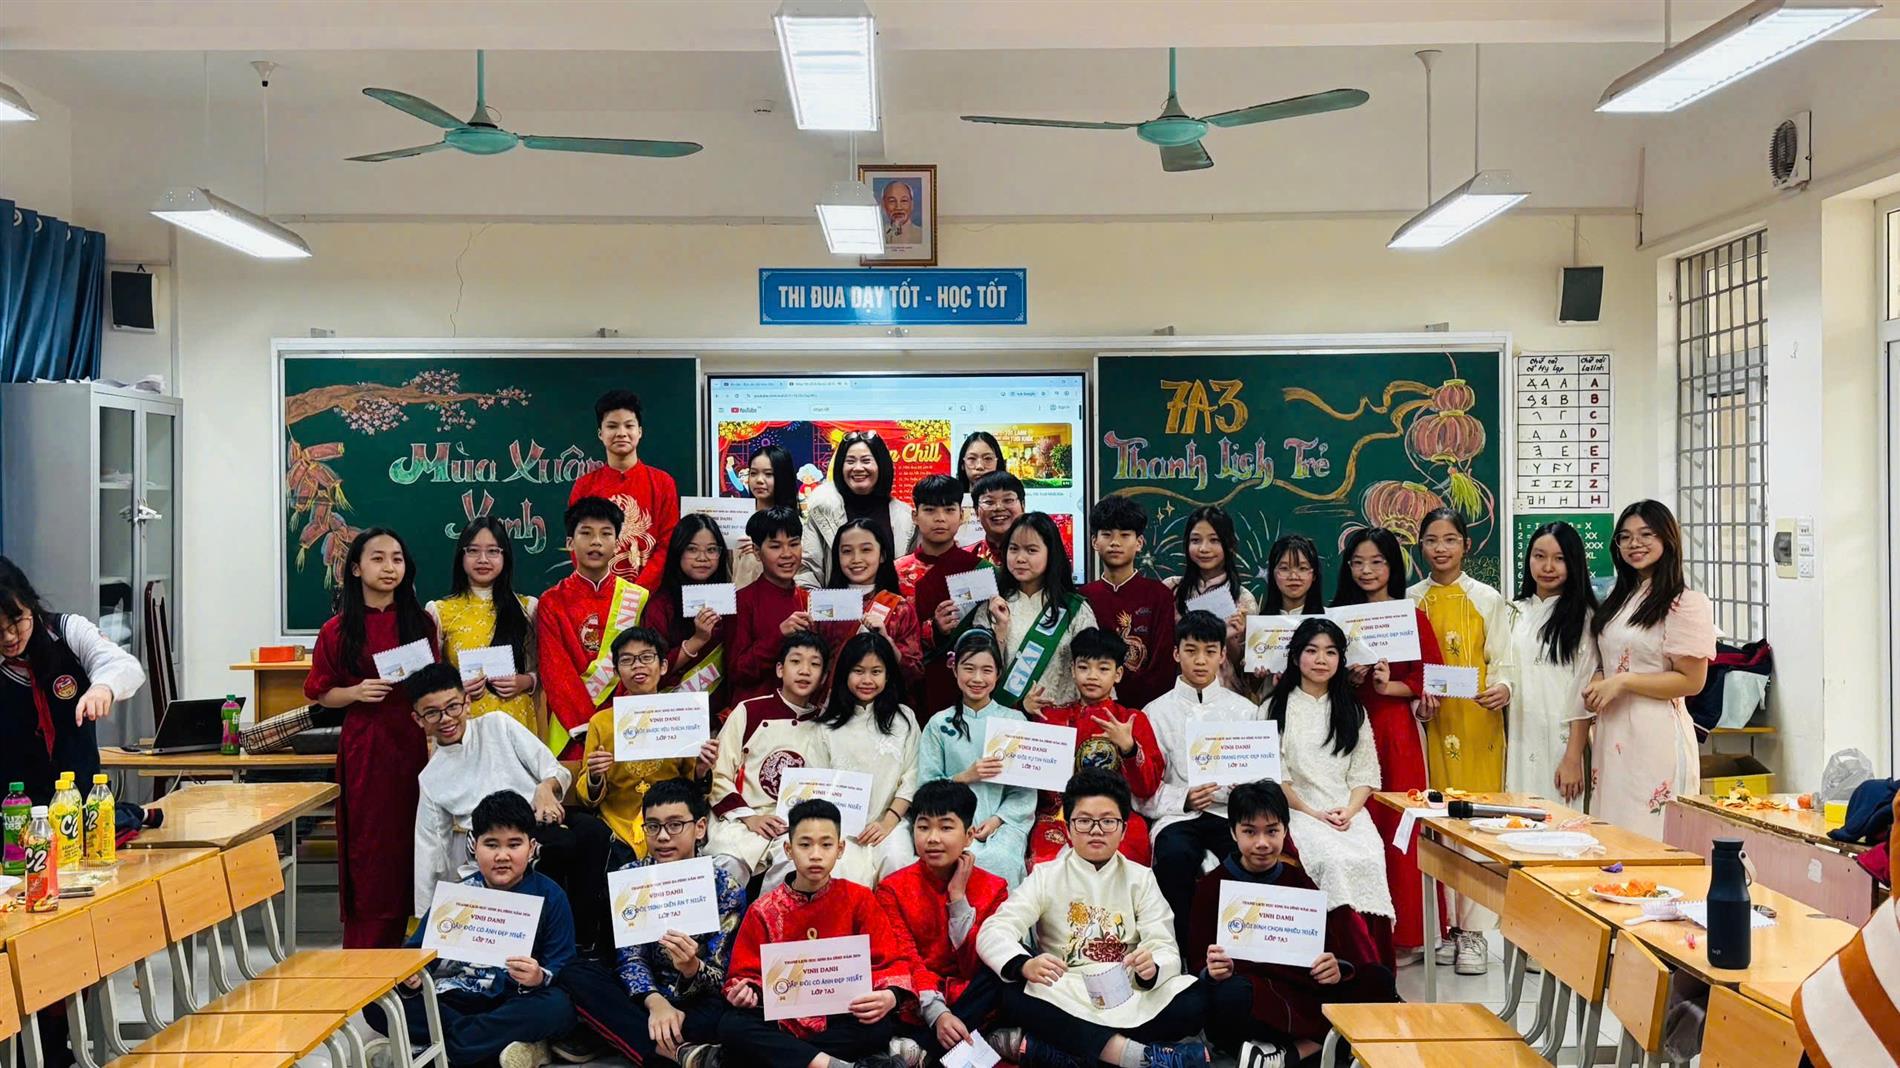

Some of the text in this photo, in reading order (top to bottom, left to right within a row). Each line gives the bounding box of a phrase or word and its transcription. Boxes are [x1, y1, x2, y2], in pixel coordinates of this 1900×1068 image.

[778, 286, 806, 308] THI
[810, 286, 846, 308] ĐUA
[851, 285, 886, 313] DẠY
[889, 278, 920, 308] TỐT
[937, 286, 972, 313] HỌC
[977, 278, 1008, 308] TỐT
[1591, 378, 1599, 388] A
[1560, 395, 1568, 405] B
[1591, 394, 1599, 404] B
[1160, 378, 1249, 435] 7A3
[1590, 410, 1598, 420] C
[1590, 428, 1597, 438] D
[902, 442, 942, 463] Chill
[1561, 446, 1569, 457] E
[1590, 446, 1599, 456] E
[389, 441, 497, 485] Mùa
[1104, 431, 1331, 490] Thanh Lịch Trẻ
[1591, 463, 1600, 473] F
[1590, 479, 1598, 488] Z
[1591, 495, 1601, 504] H
[1518, 522, 1522, 530] 1
[1585, 522, 1592, 530] X
[1517, 532, 1523, 540] 2
[1585, 532, 1598, 540] XX
[1518, 542, 1523, 550] 3
[1585, 542, 1604, 550] XXX
[1585, 551, 1597, 560] XL
[1517, 561, 1523, 569] 5
[1517, 571, 1523, 579] 6
[1517, 581, 1523, 589] 7
[4, 813, 27, 823] fuze
[4, 822, 21, 830] tea
[25, 847, 48, 872] C2
[471, 914, 506, 924] VINH DANH
[1259, 912, 1295, 922] VINH DANH
[811, 988, 823, 996] LỚP
